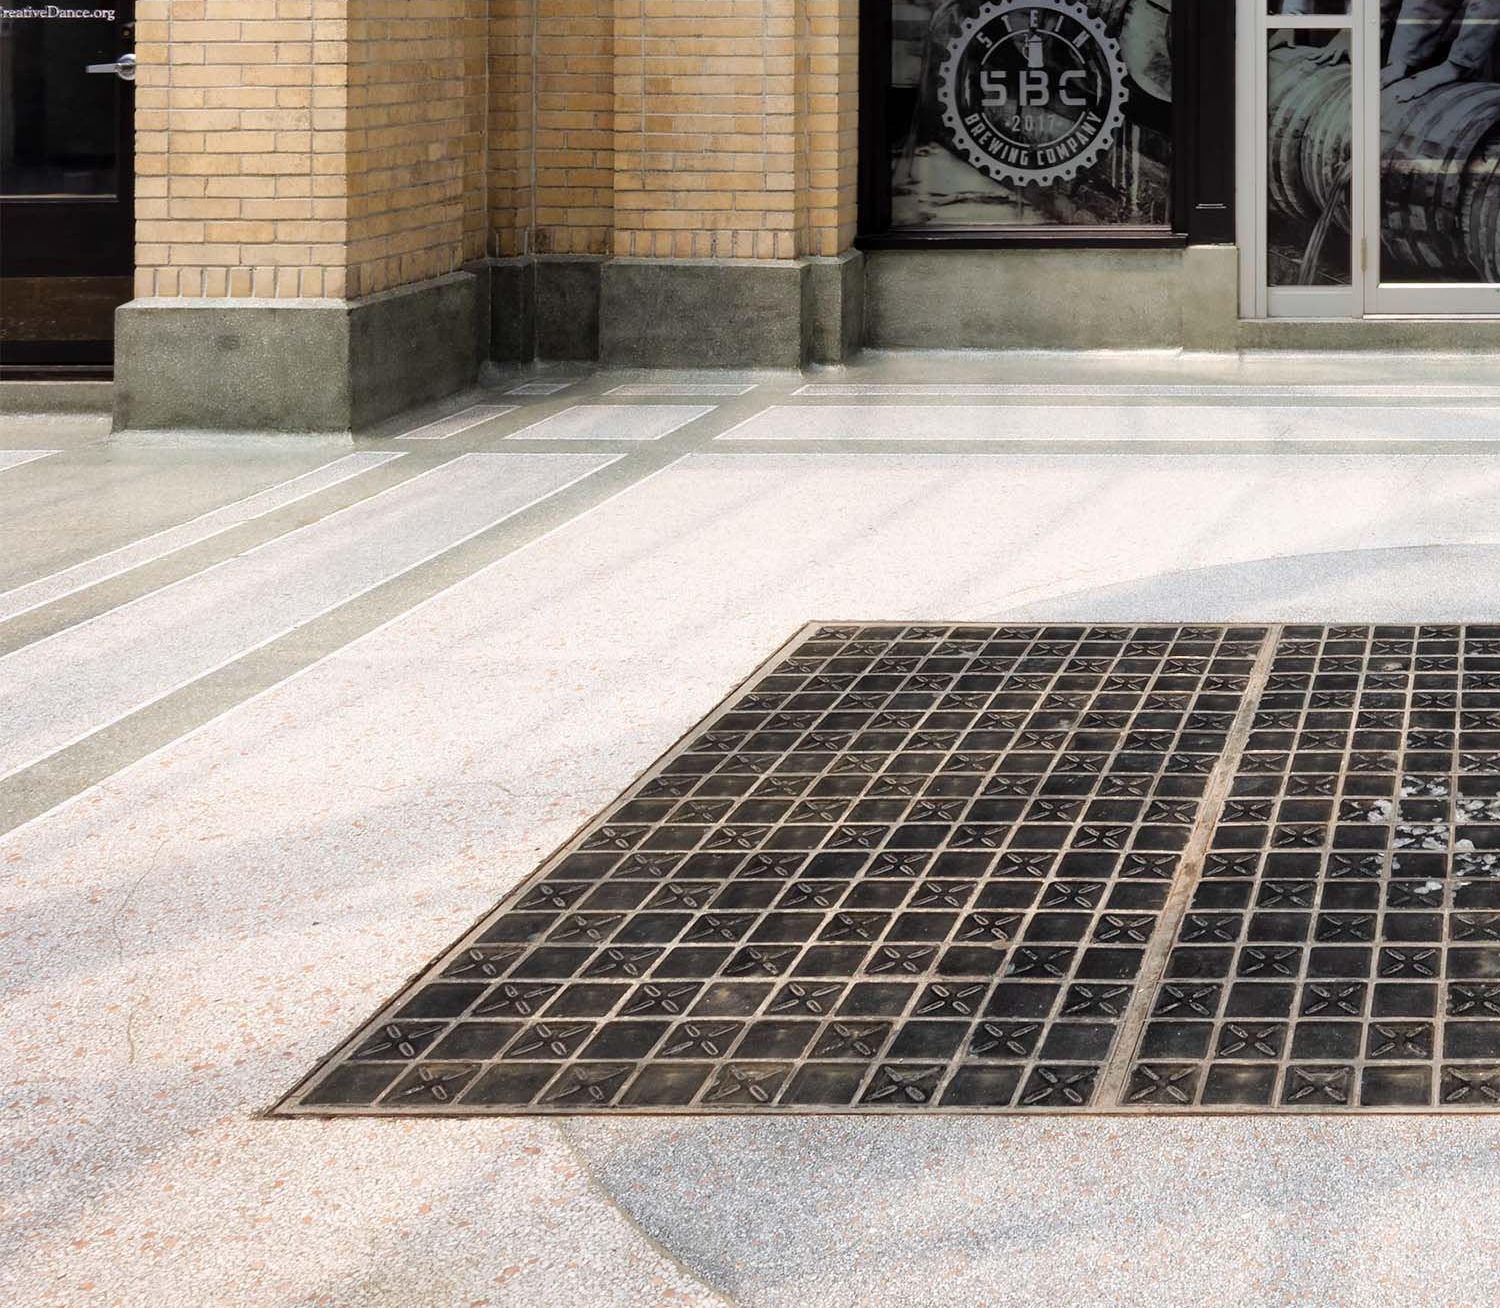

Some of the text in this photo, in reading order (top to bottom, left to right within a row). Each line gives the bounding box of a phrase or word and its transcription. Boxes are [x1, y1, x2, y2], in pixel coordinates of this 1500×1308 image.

[976, 9, 1091, 49] STEIN
[980, 70, 1087, 107] SBC
[965, 111, 1103, 166] BREWING COMPANY
[1011, 114, 1056, 132] 2017
